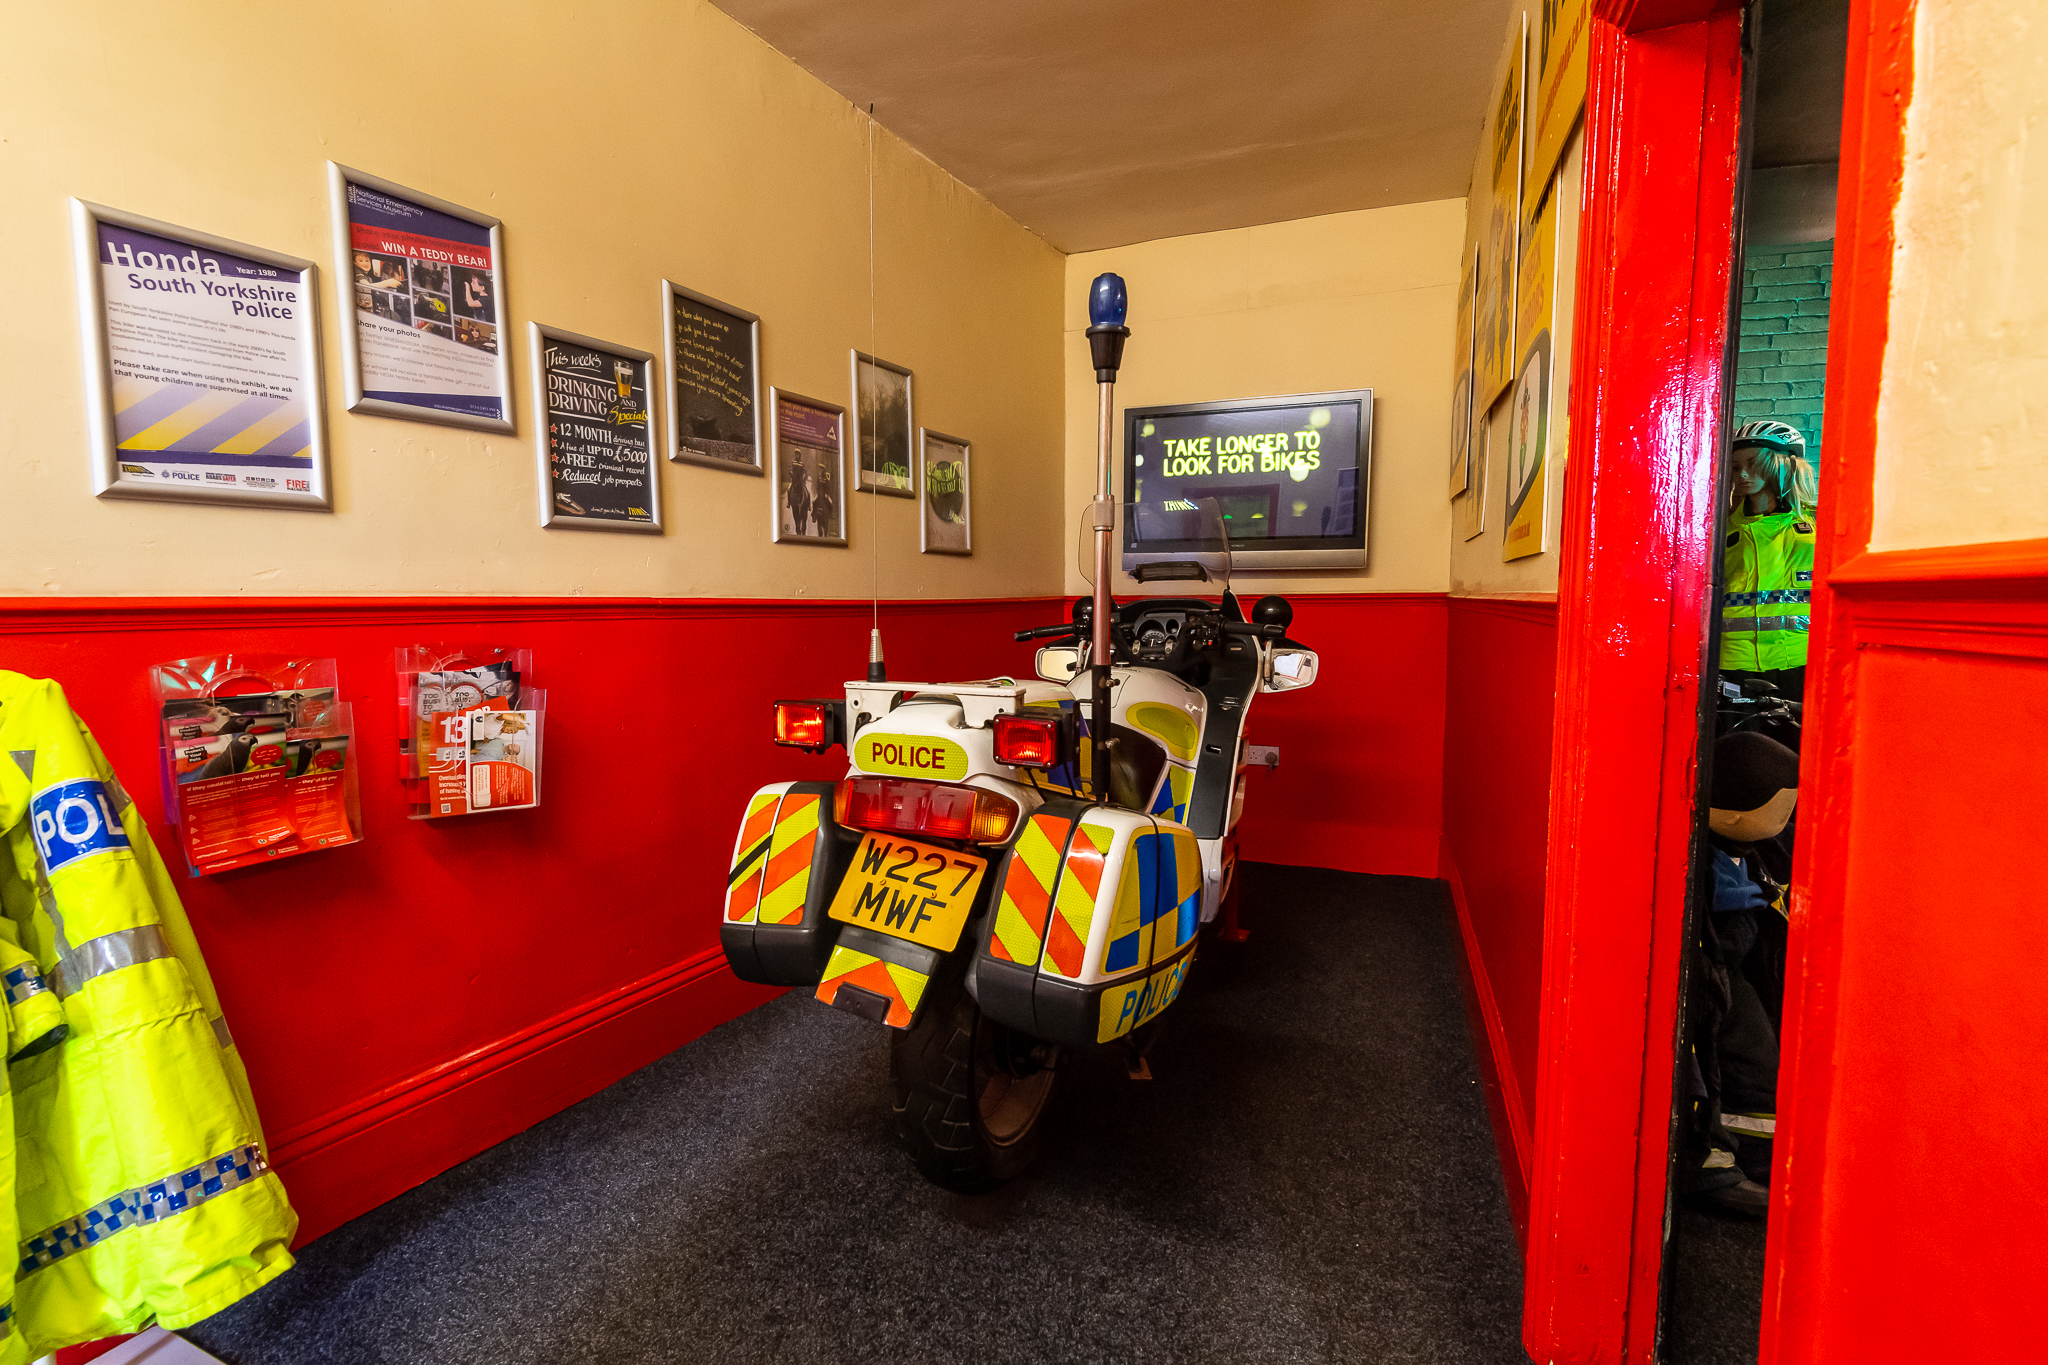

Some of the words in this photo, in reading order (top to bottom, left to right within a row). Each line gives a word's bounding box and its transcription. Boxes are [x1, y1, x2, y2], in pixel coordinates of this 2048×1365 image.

[356, 188, 384, 202] National
[386, 198, 424, 216] Emergency
[356, 196, 382, 208] Services
[384, 204, 412, 218] Museum
[107, 242, 222, 277] Honda
[236, 266, 257, 275] Year:
[258, 268, 277, 277] 1980
[382, 241, 406, 255] WIN
[410, 246, 418, 256] A
[420, 248, 454, 262] TEDDY
[458, 254, 488, 268] BEAR!
[128, 273, 196, 294] South
[200, 280, 297, 303] Yorkshire
[232, 300, 292, 320] Police
[396, 328, 420, 338] photos
[544, 346, 568, 368] This
[571, 353, 602, 368] week's
[114, 359, 140, 369] Please
[142, 364, 160, 372] take
[204, 374, 224, 384] using
[242, 380, 268, 390] exhibit,
[114, 369, 132, 378] that
[134, 373, 160, 382] young
[162, 376, 194, 386] children
[210, 385, 248, 394] supervised
[548, 374, 618, 402] DRINKING
[548, 391, 608, 416] DRIVING
[620, 399, 636, 408] AND
[607, 405, 648, 426] Specials
[560, 422, 572, 436] 12
[574, 424, 612, 444] MONTH
[1163, 436, 1212, 458] TAKE
[1216, 432, 1288, 454] LONGER
[1294, 430, 1320, 450] TO
[560, 442, 566, 450] A
[566, 442, 578, 452] fine
[578, 444, 585, 454] of
[613, 446, 648, 464] £5000
[560, 456, 566, 464] A
[566, 452, 597, 469] FREE
[598, 462, 624, 472] criminal
[626, 466, 646, 475] record
[1163, 456, 1212, 477] LOOK
[1218, 454, 1254, 474] FOR
[1260, 450, 1320, 472] BIKES
[172, 472, 200, 480] POLICE
[286, 479, 306, 488] FIRE
[560, 468, 602, 482] Reduced
[602, 475, 614, 486] job
[614, 478, 643, 488] prospects
[872, 742, 945, 769] POLICE
[860, 838, 978, 897] W227
[852, 882, 947, 934] MWF
